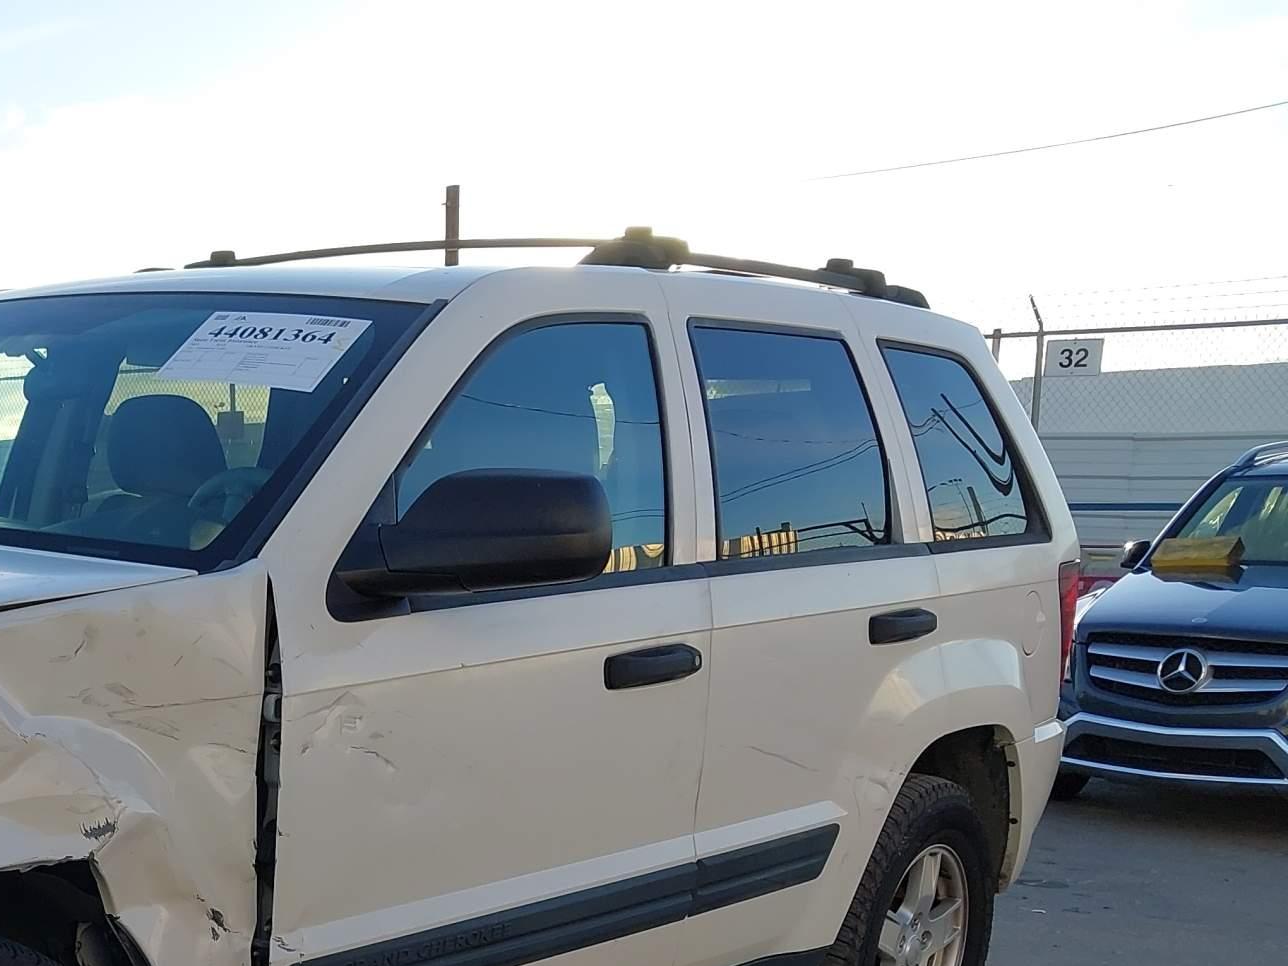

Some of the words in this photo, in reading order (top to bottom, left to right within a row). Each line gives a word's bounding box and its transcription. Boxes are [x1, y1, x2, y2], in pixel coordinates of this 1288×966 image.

[208, 325, 337, 344] 44081364
[1059, 348, 1089, 368] 32
[415, 922, 513, 960] CHEROKEE
